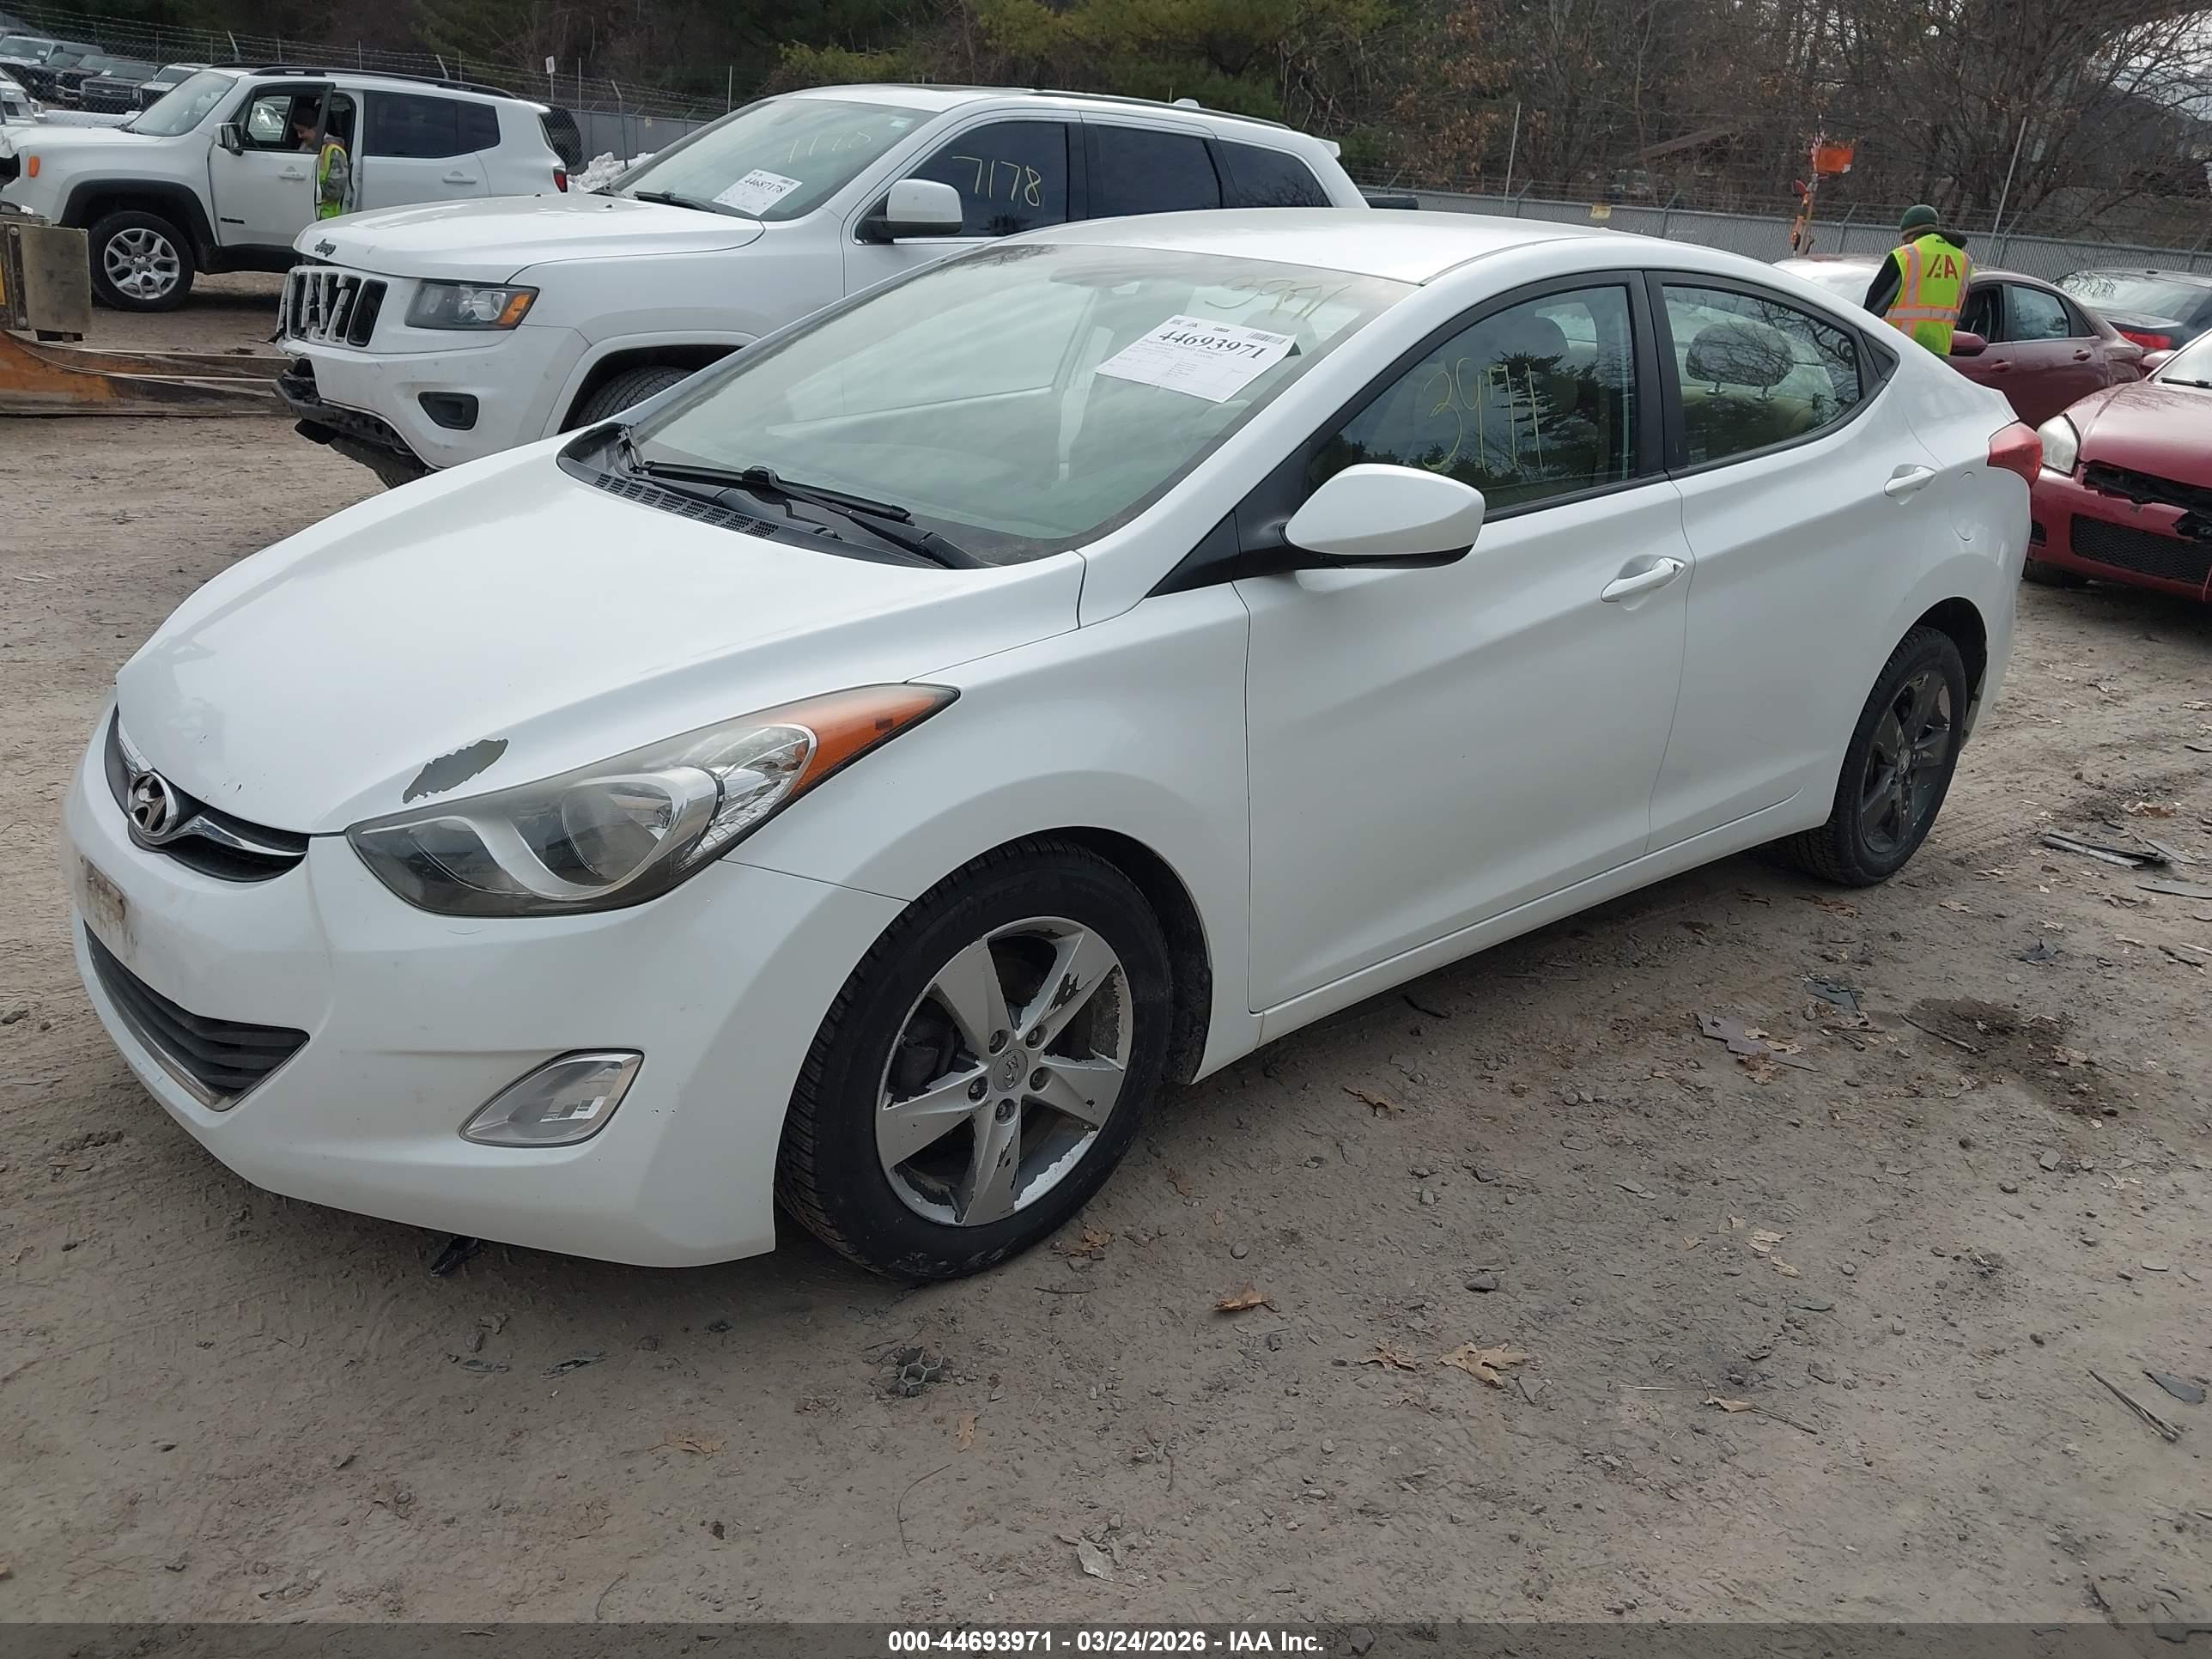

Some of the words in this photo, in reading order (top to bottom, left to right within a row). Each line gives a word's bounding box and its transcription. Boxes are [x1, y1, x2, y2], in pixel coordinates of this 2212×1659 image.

[744, 177, 787, 194] 44687178
[951, 155, 1042, 207] 7178
[1158, 330, 1268, 360] 44693971
